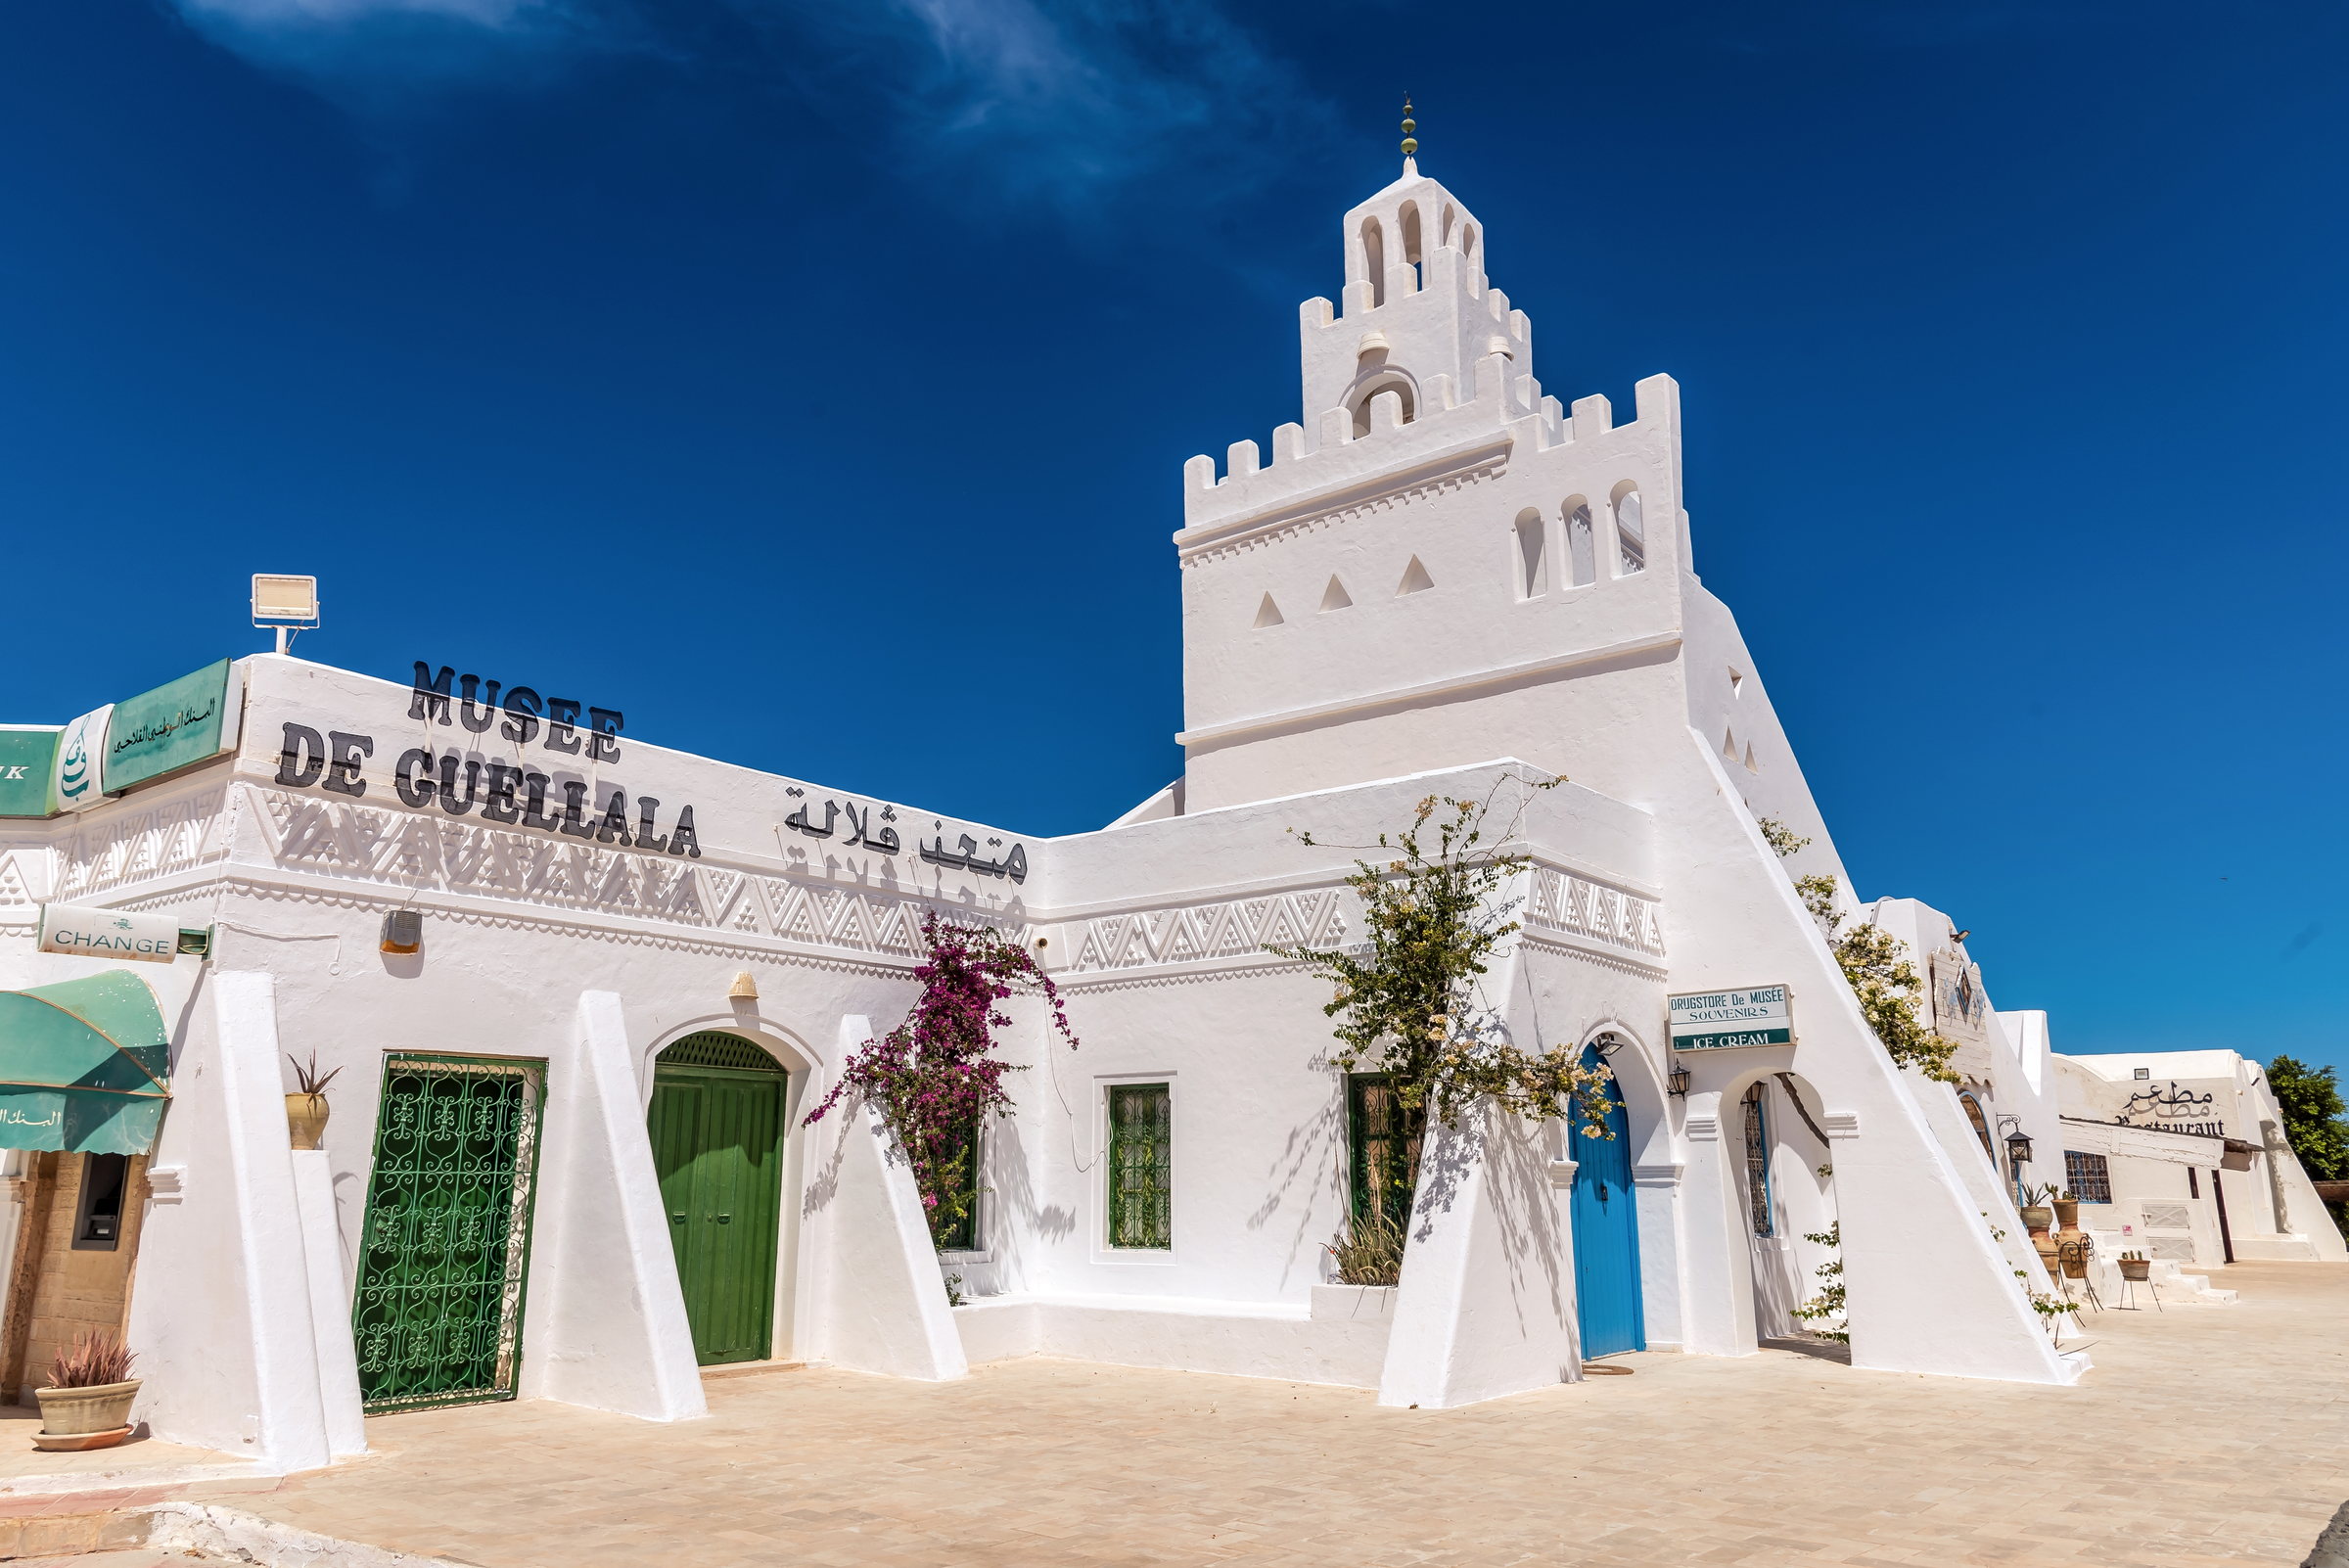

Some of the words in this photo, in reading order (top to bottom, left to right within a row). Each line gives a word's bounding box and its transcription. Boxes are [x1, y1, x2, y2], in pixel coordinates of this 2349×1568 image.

[184, 697, 215, 726] البنك
[407, 660, 624, 764] MUSEE
[114, 724, 149, 754] الفلاحي
[275, 722, 374, 798] DE
[395, 749, 702, 858] GUELLALA
[919, 819, 1029, 886] متحف
[55, 930, 170, 954] CHANGE
[1670, 994, 1727, 1011] DRUGSTORE
[1731, 993, 1745, 1006] De
[1750, 987, 1784, 1004] MUSÉE
[1689, 1006, 1769, 1021] SOUVENIRS
[1693, 1037, 1714, 1049] ICE
[1719, 1033, 1769, 1047] CREAM
[2122, 1080, 2213, 1109] مطعم
[7, 1109, 62, 1127] البنك
